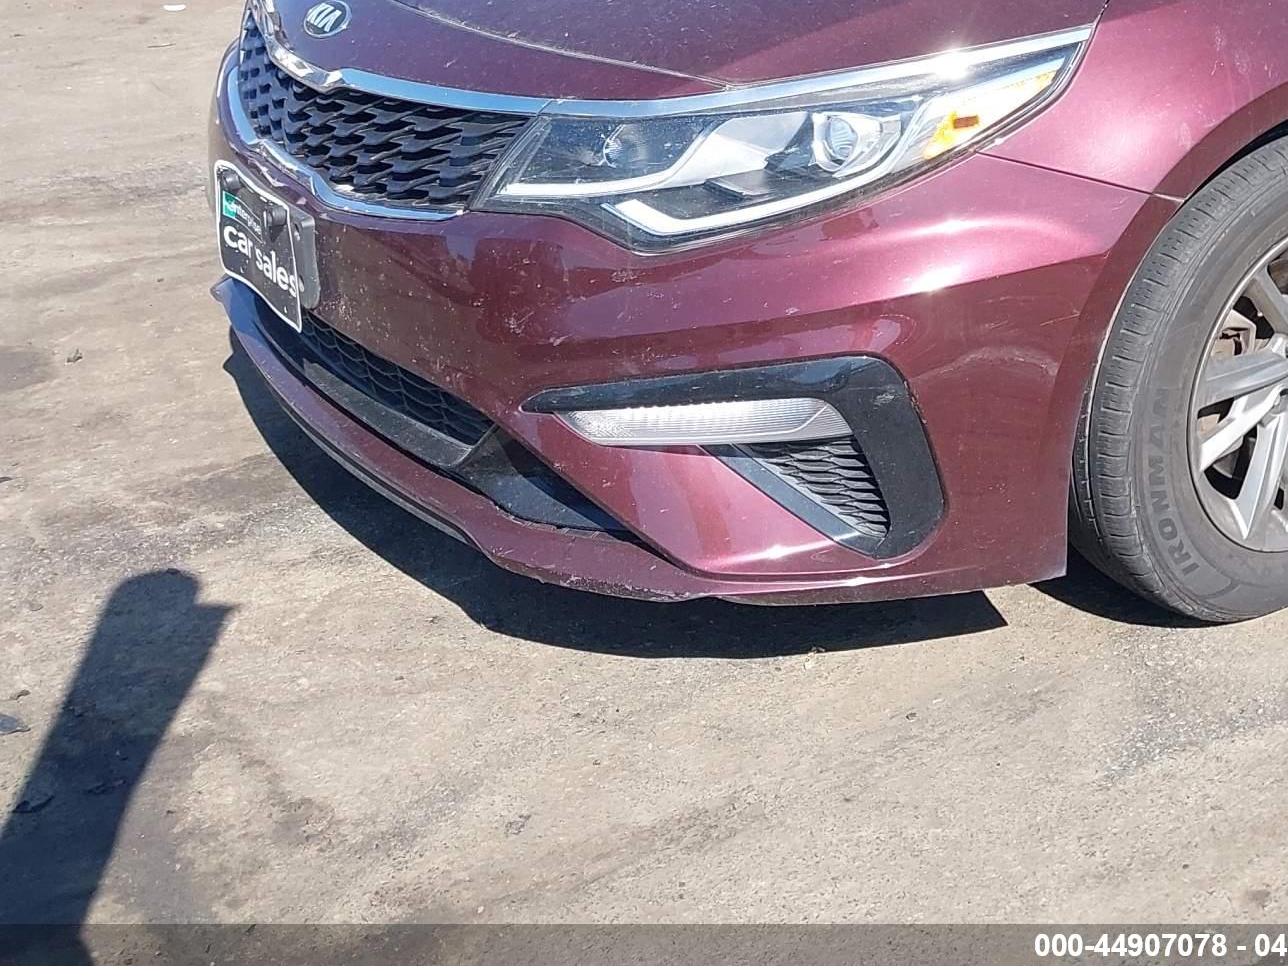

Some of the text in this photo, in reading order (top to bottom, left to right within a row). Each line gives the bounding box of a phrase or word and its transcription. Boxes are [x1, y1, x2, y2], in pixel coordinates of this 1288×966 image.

[223, 225, 297, 298] car sales
[1148, 388, 1201, 576] IRONMAN
